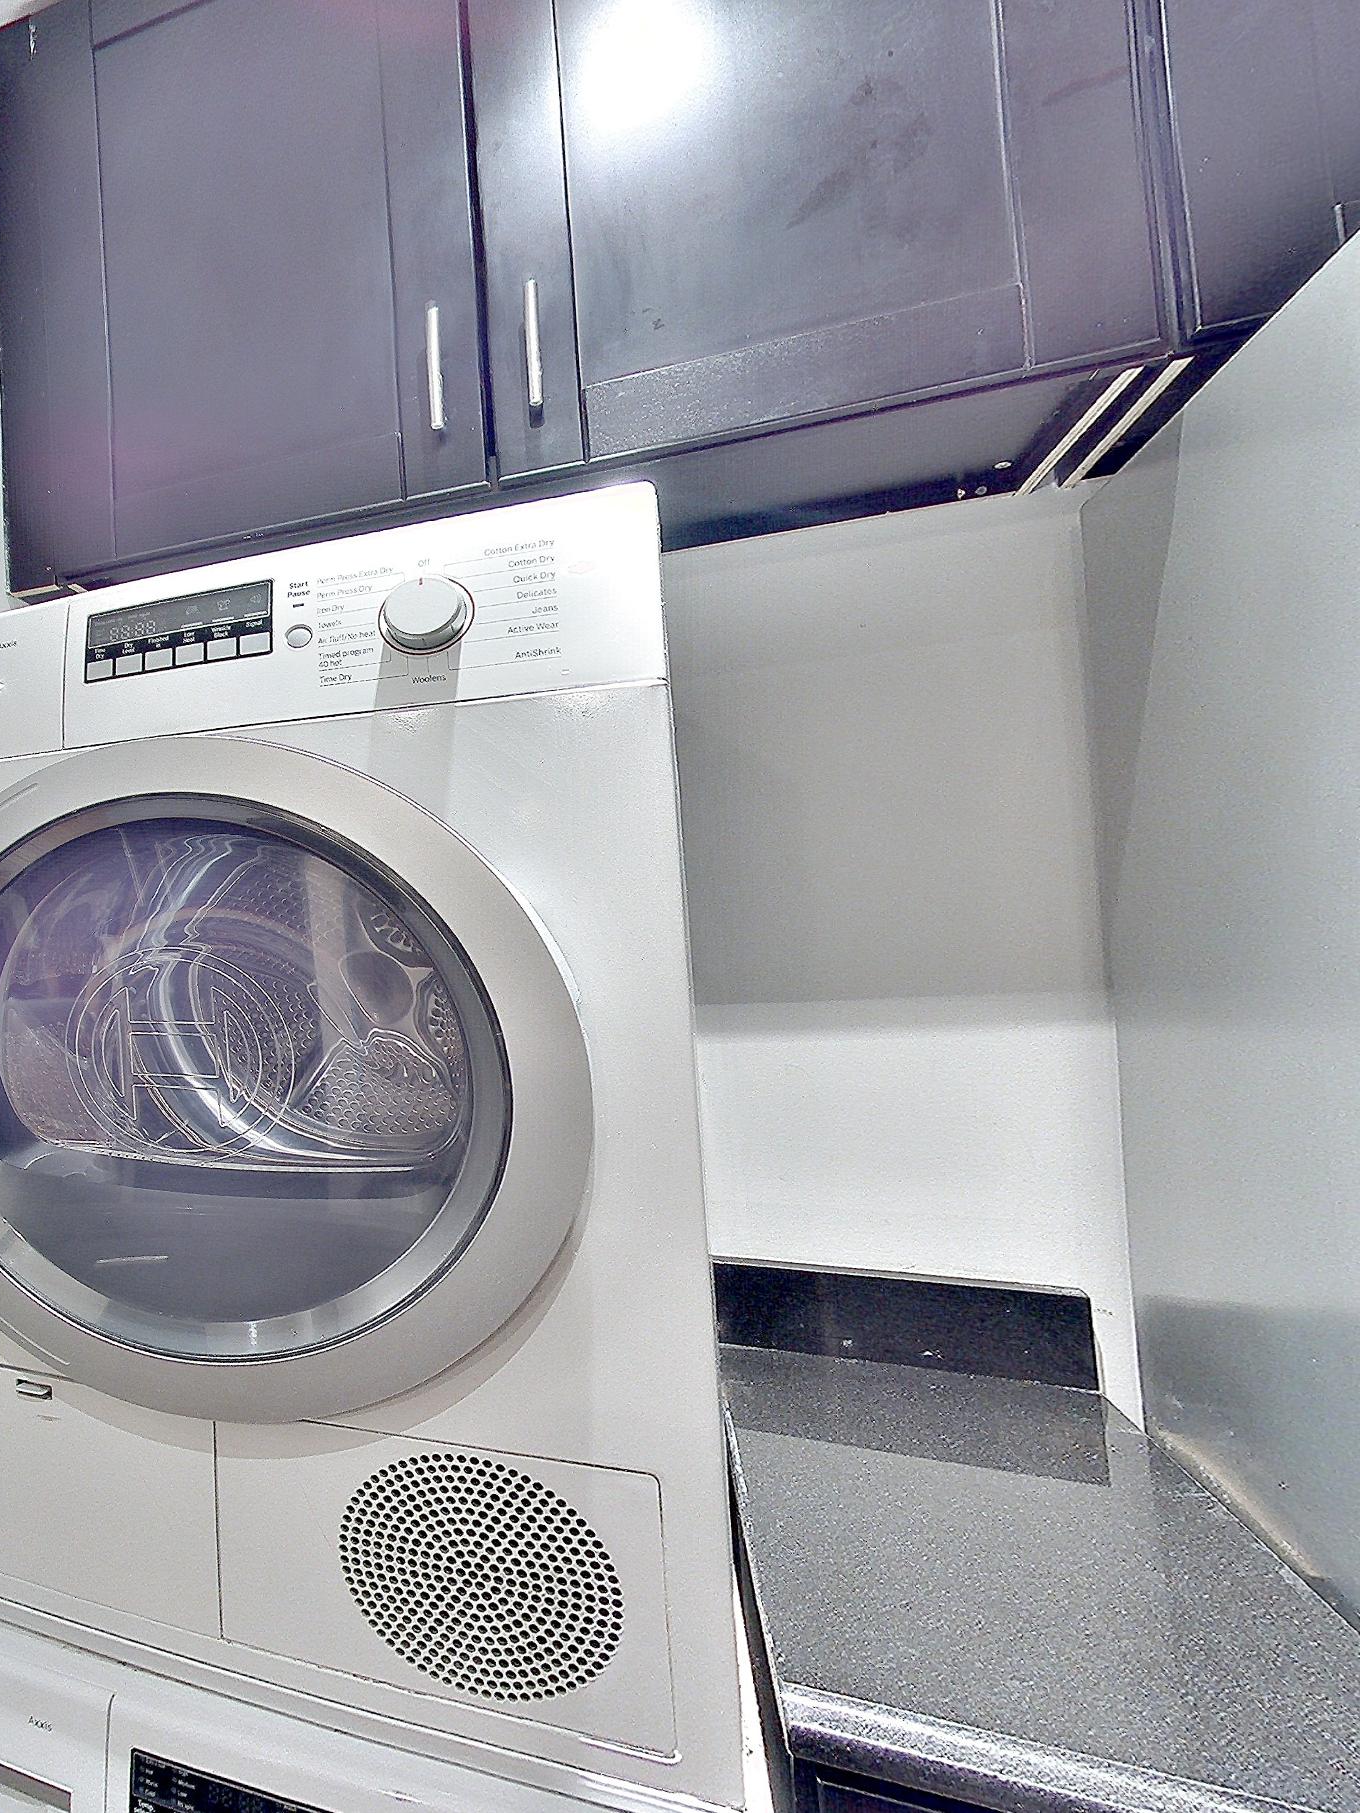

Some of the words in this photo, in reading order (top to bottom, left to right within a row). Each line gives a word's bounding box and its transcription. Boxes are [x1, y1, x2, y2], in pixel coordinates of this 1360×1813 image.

[483, 546, 513, 557] Cotton
[514, 542, 537, 552] Extra
[538, 539, 556, 549] Dry
[507, 557, 538, 568] Cotton
[539, 555, 556, 564] Dry
[512, 574, 538, 584] Quick
[539, 571, 557, 581] Dry
[288, 580, 310, 590] Start
[358, 584, 373, 594] Dry
[286, 589, 311, 599] Pause
[516, 587, 558, 600] Delicates
[331, 604, 345, 613] Dry
[531, 604, 559, 615] Jeans
[244, 618, 263, 629] Signal
[507, 624, 535, 635] Active
[536, 621, 560, 631] Wear
[318, 650, 341, 660] Timed
[341, 647, 374, 658] program
[514, 646, 562, 660] AntiShrink
[319, 675, 338, 684] Time
[339, 673, 353, 682] Dry
[410, 674, 448, 685] Woolens
[27, 1715, 55, 1733] Axxis
